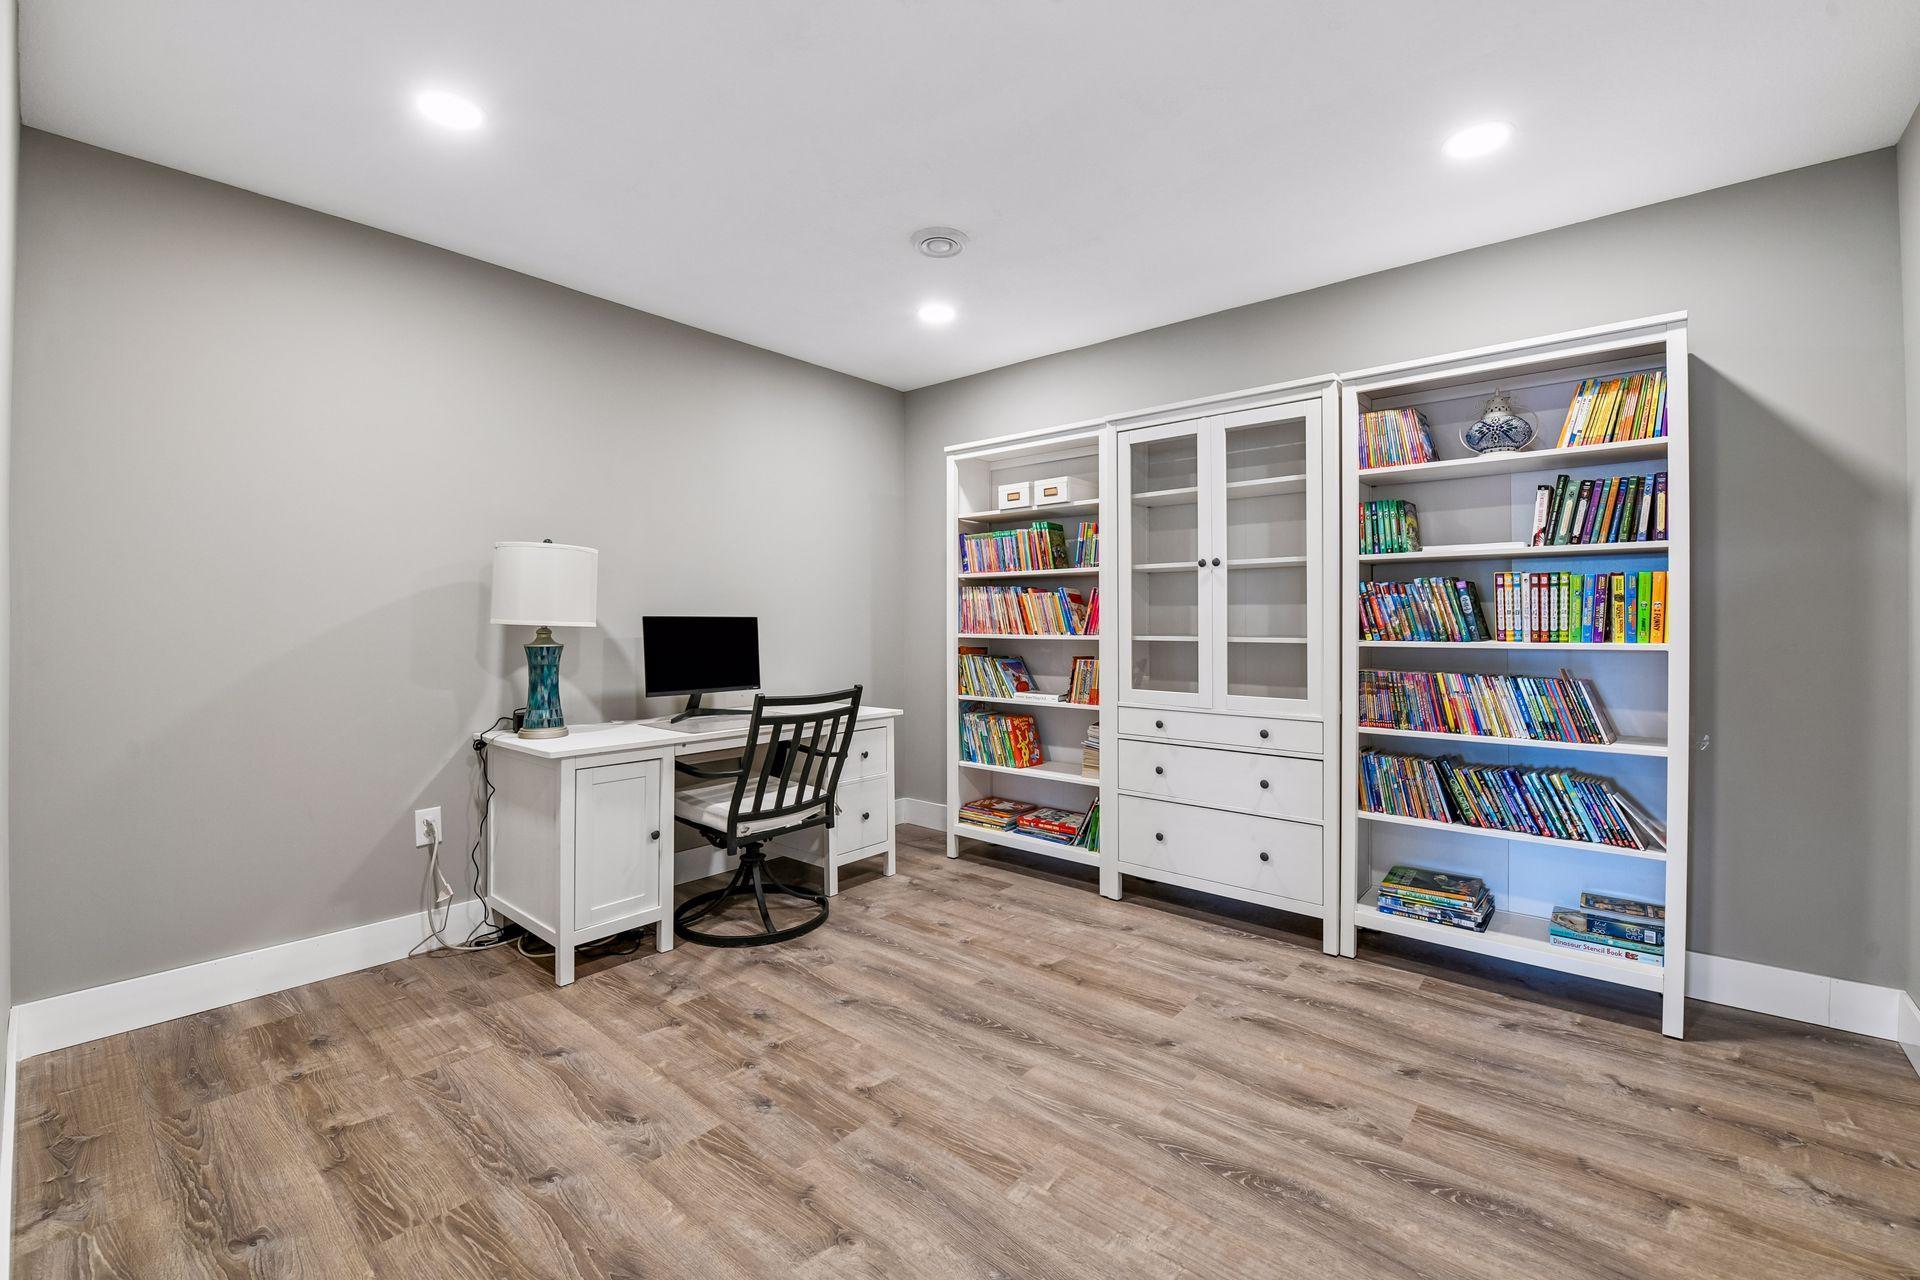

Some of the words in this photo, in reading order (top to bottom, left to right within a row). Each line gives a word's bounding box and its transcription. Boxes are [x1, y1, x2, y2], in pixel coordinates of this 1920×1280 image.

[1653, 614, 1662, 631] FUNNY
[1553, 937, 1581, 949] Dinosaur
[1583, 944, 1605, 954] Stencil
[1606, 948, 1623, 957] Book
